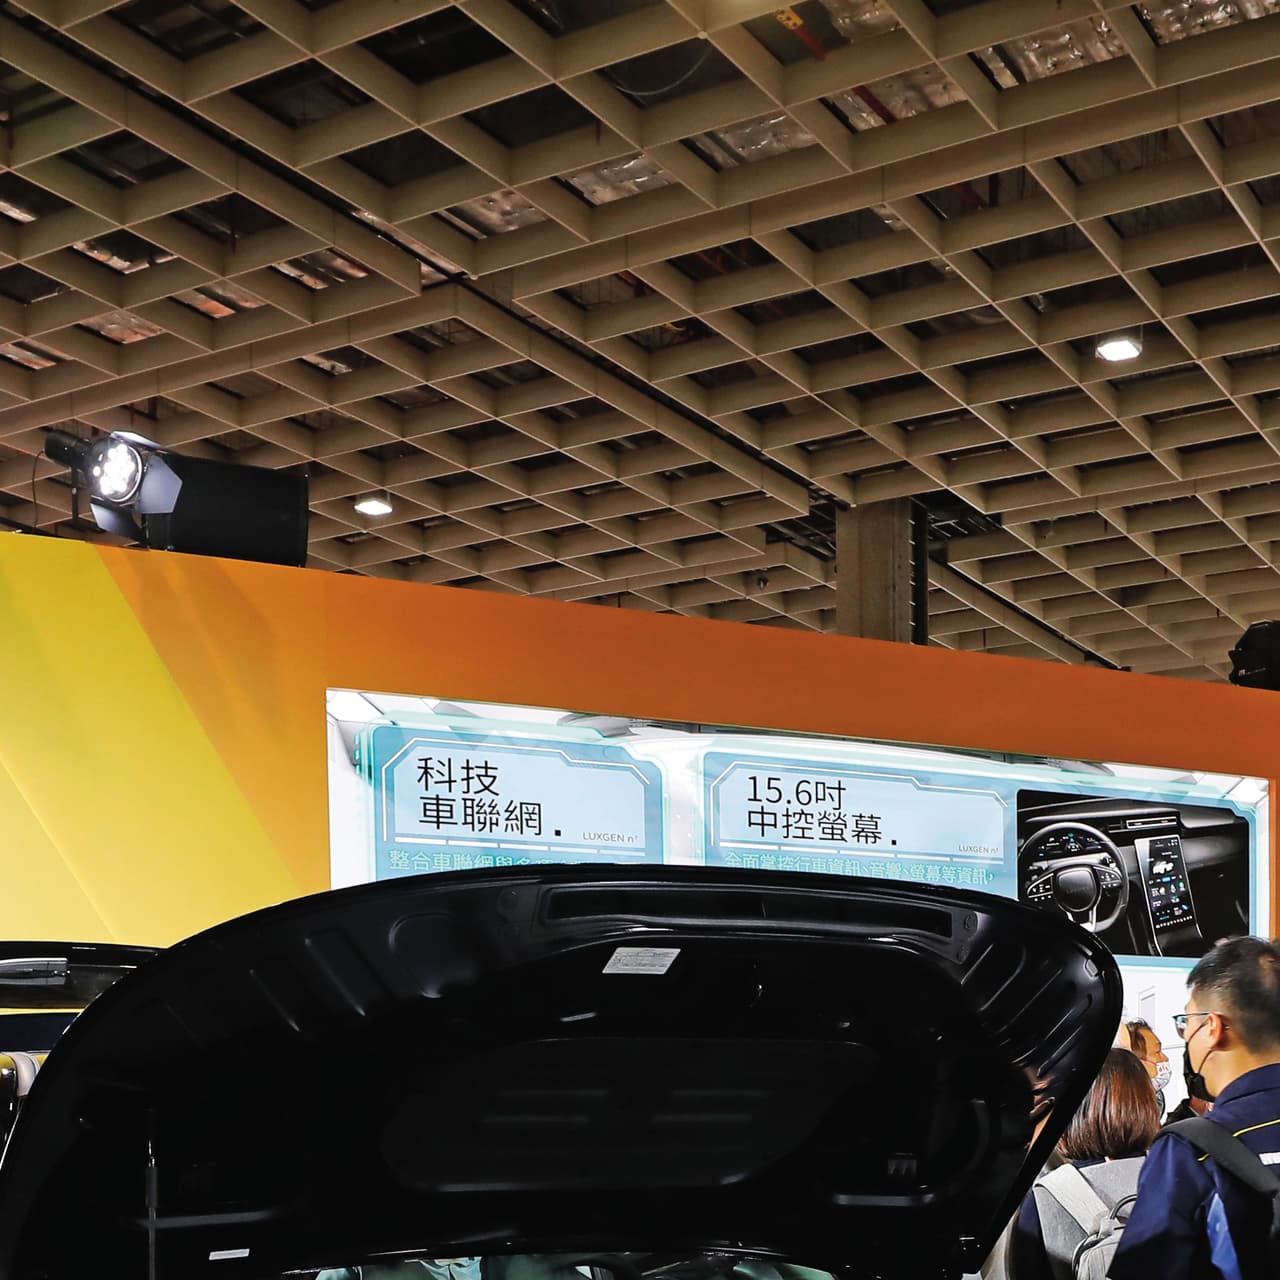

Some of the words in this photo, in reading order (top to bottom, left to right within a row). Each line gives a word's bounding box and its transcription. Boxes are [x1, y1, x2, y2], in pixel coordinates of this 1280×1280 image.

[416, 756, 500, 797] 科技
[747, 775, 847, 810] 15.6吋
[582, 831, 625, 842] LUXGEN
